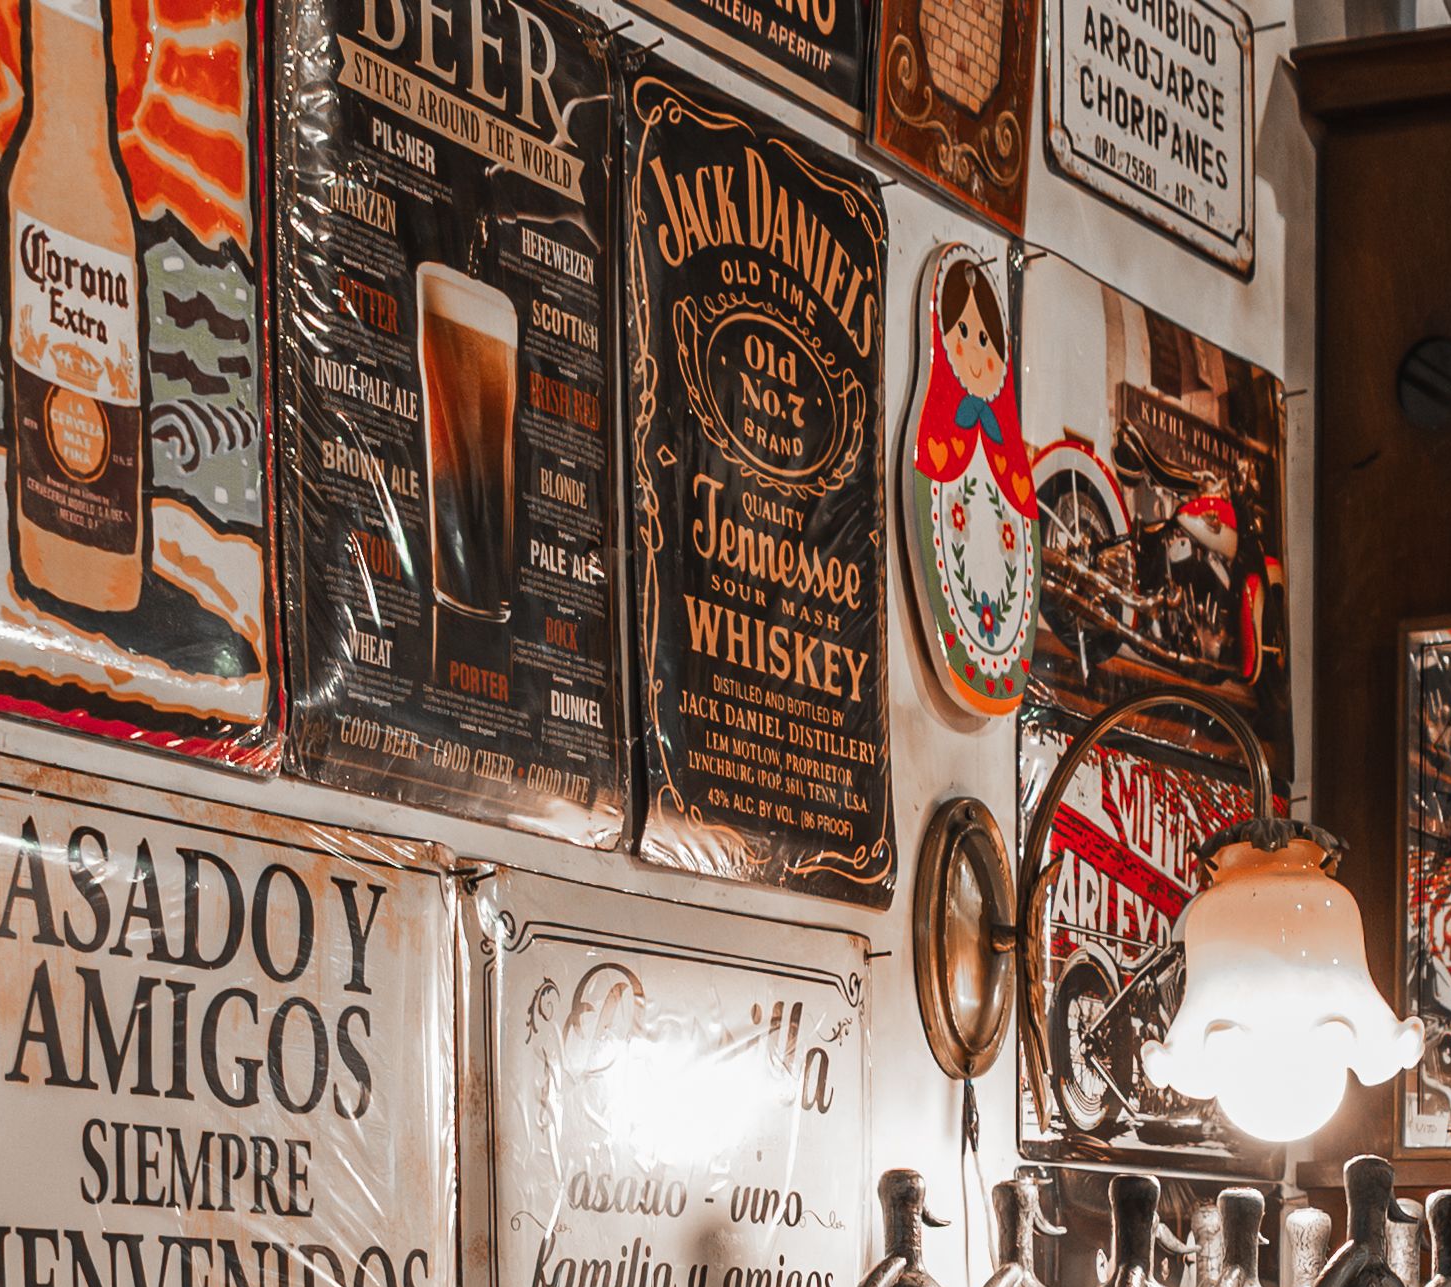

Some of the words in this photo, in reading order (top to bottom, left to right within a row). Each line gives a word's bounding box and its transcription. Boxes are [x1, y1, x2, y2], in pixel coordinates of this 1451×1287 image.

[1084, 5, 1225, 132] ARROJARSE
[354, 52, 411, 109] STYLES
[417, 86, 480, 145] AROUND
[486, 117, 515, 162] THE
[520, 141, 572, 190] WORLD
[372, 117, 436, 175] PILSNER
[1080, 65, 1228, 190] CHORIPANES
[19, 223, 131, 309] Corona
[521, 227, 595, 286] HEFEWEIZEN
[650, 156, 745, 267] JACK
[744, 147, 874, 357] DANIEL'S
[49, 287, 109, 345] Extra
[338, 273, 399, 335] BITTER
[721, 259, 761, 285] OLD
[769, 269, 817, 326] TIME
[532, 299, 599, 353] SCOTTISH
[314, 356, 355, 392] INDIA
[358, 372, 391, 411] PALE
[395, 386, 419, 422] ALE
[744, 334, 798, 388] Old
[744, 417, 804, 458] BRAND
[322, 440, 387, 483] BROWN
[391, 466, 419, 500] ALE
[540, 466, 589, 510] BLONDE
[692, 473, 862, 611] Tennessee
[742, 491, 805, 533] QUALITY
[531, 538, 567, 578] PALE
[711, 574, 767, 608] SOUR
[782, 597, 841, 632] MASH
[348, 628, 393, 669] WHEAT
[545, 617, 578, 654] BOCK
[683, 594, 870, 703] WHISKEY
[450, 660, 509, 703] PORTER
[551, 689, 605, 731] DUNKEL
[679, 690, 720, 723] JACK
[725, 703, 784, 740] DANIEL
[789, 721, 877, 765] DISTILLERY
[340, 714, 379, 751] GOOD
[382, 724, 420, 761] BEER
[433, 737, 471, 775] GOOD
[474, 747, 515, 785] CHEER
[527, 763, 560, 797] GOOD
[563, 772, 591, 805] LIFE
[329, 874, 388, 996] Y
[5, 959, 373, 1121] AMIGOS
[80, 1118, 315, 1218] SIEMPRE
